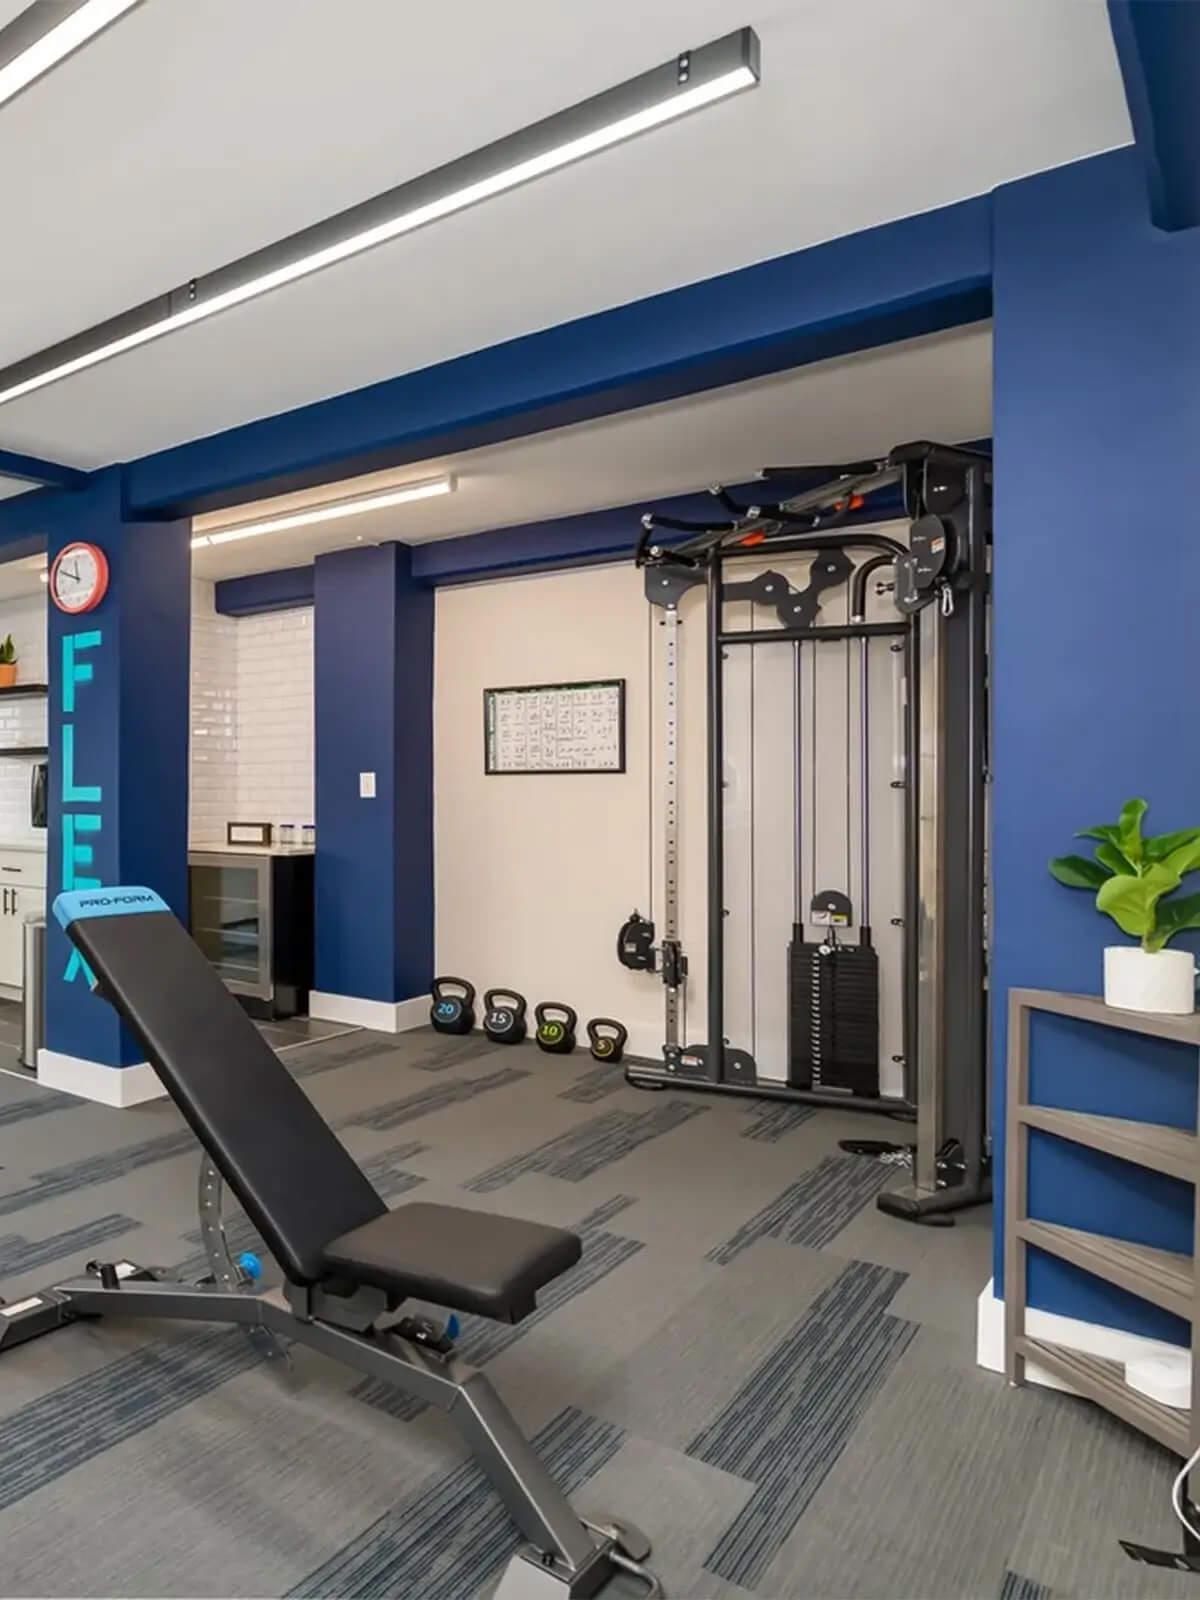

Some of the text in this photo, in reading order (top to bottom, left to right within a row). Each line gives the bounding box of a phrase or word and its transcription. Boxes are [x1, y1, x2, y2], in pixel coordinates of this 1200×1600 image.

[437, 1003, 454, 1014] 20
[490, 1012, 507, 1025] 15
[542, 1025, 558, 1036] 10
